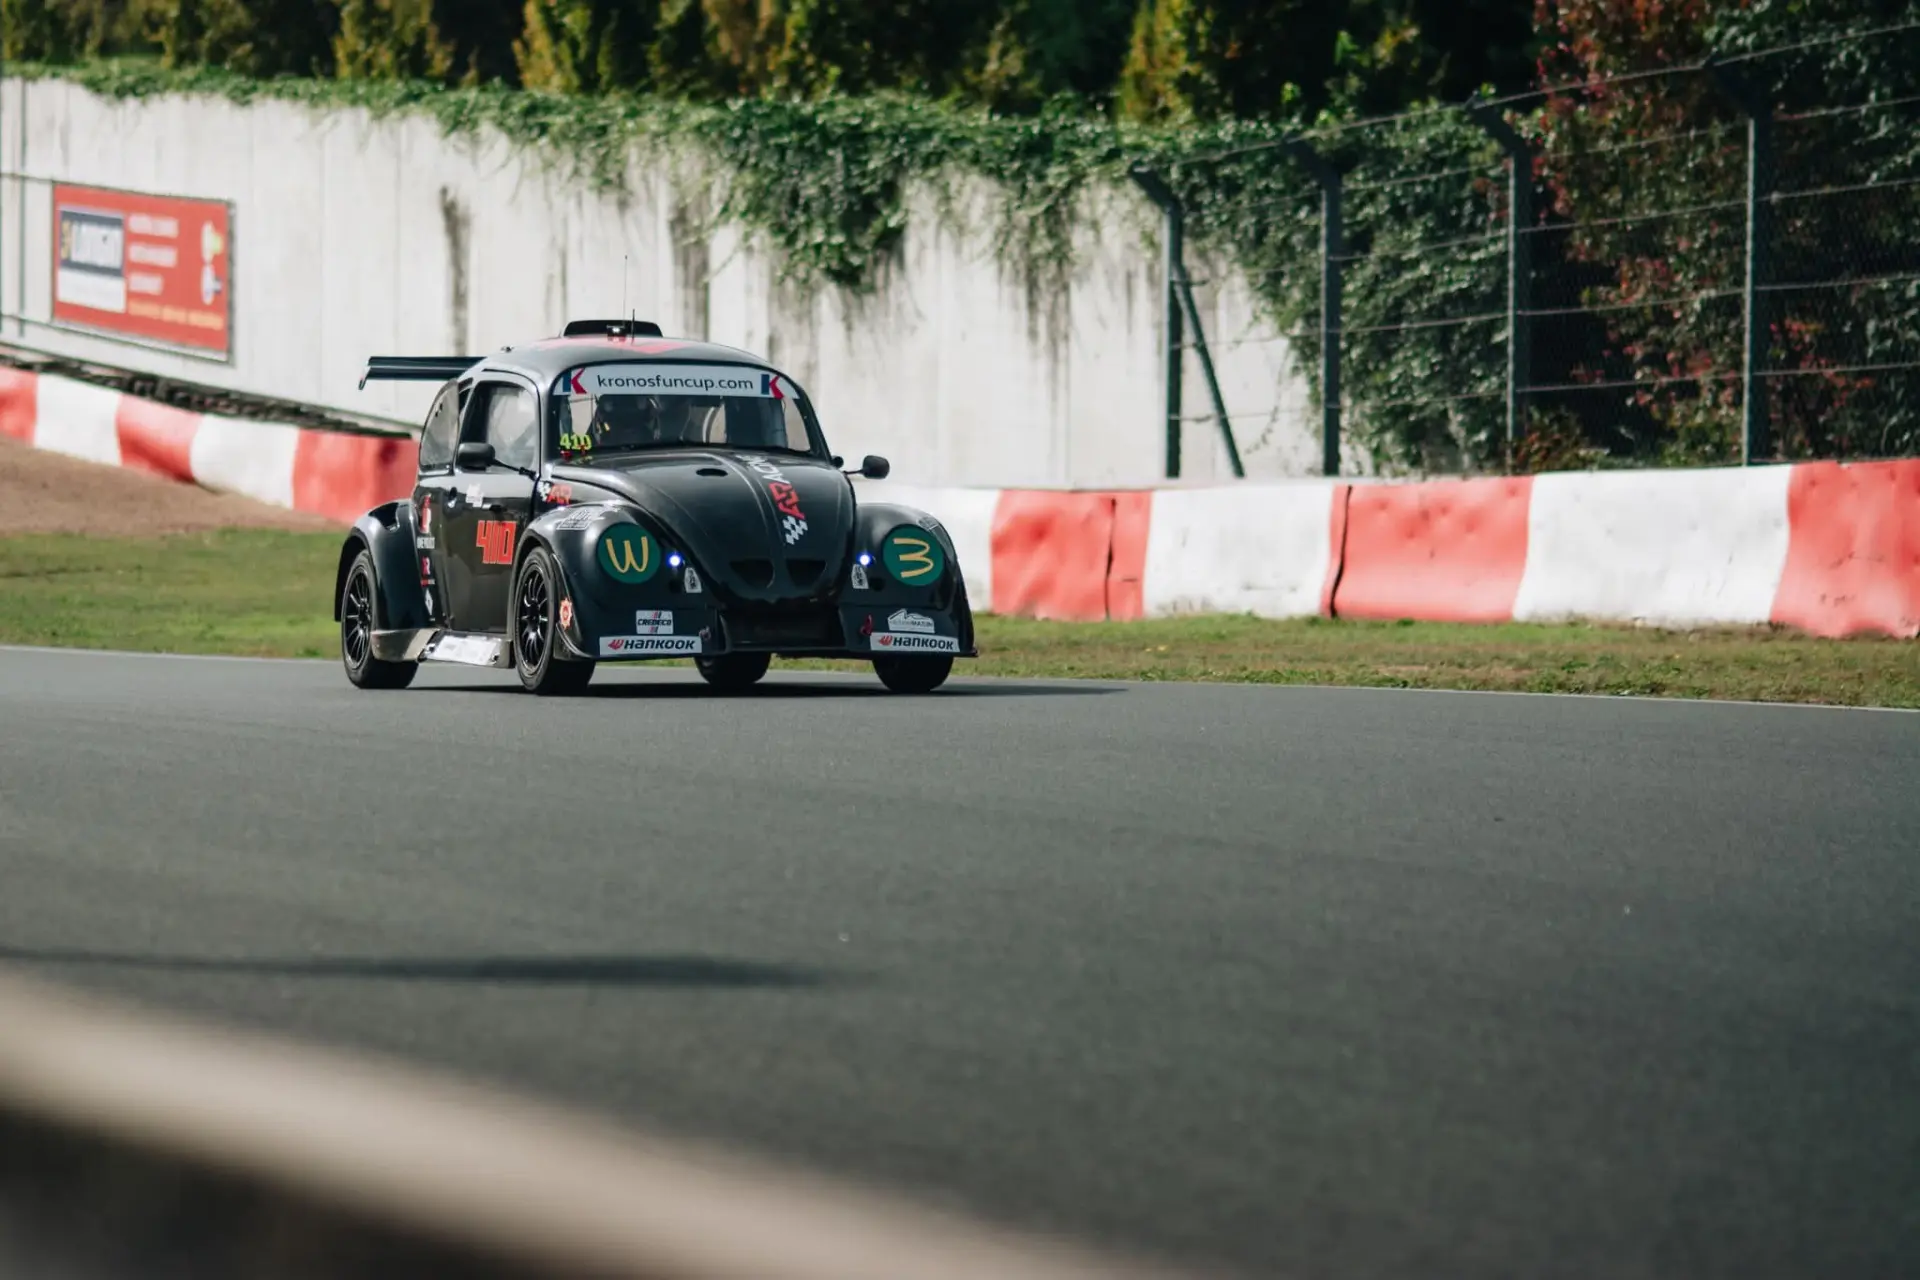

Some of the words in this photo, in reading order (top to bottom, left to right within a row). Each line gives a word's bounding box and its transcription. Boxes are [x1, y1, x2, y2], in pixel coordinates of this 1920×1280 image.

[597, 374, 753, 391] kronosfuncup.com
[560, 433, 592, 450] 410
[476, 520, 517, 565] 410
